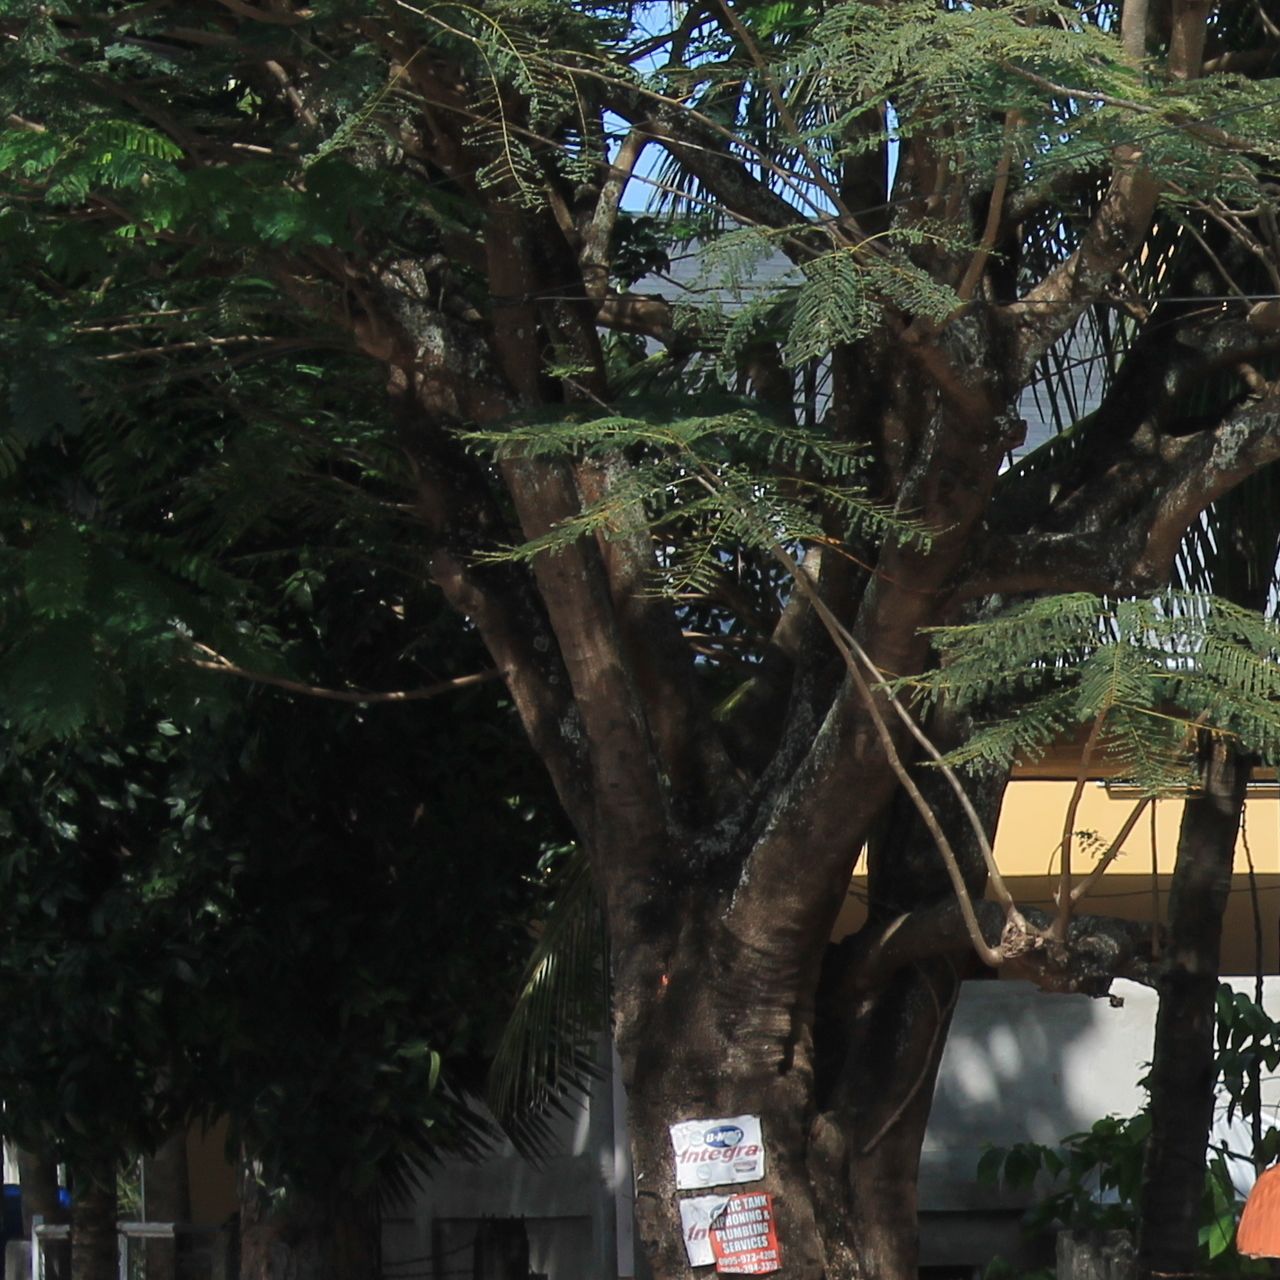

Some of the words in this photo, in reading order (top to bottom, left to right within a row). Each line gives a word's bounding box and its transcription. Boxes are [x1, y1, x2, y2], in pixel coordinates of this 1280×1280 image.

[680, 1144, 758, 1163] Integra
[742, 1195, 767, 1209] TANK
[723, 1235, 768, 1254] SERVICES
